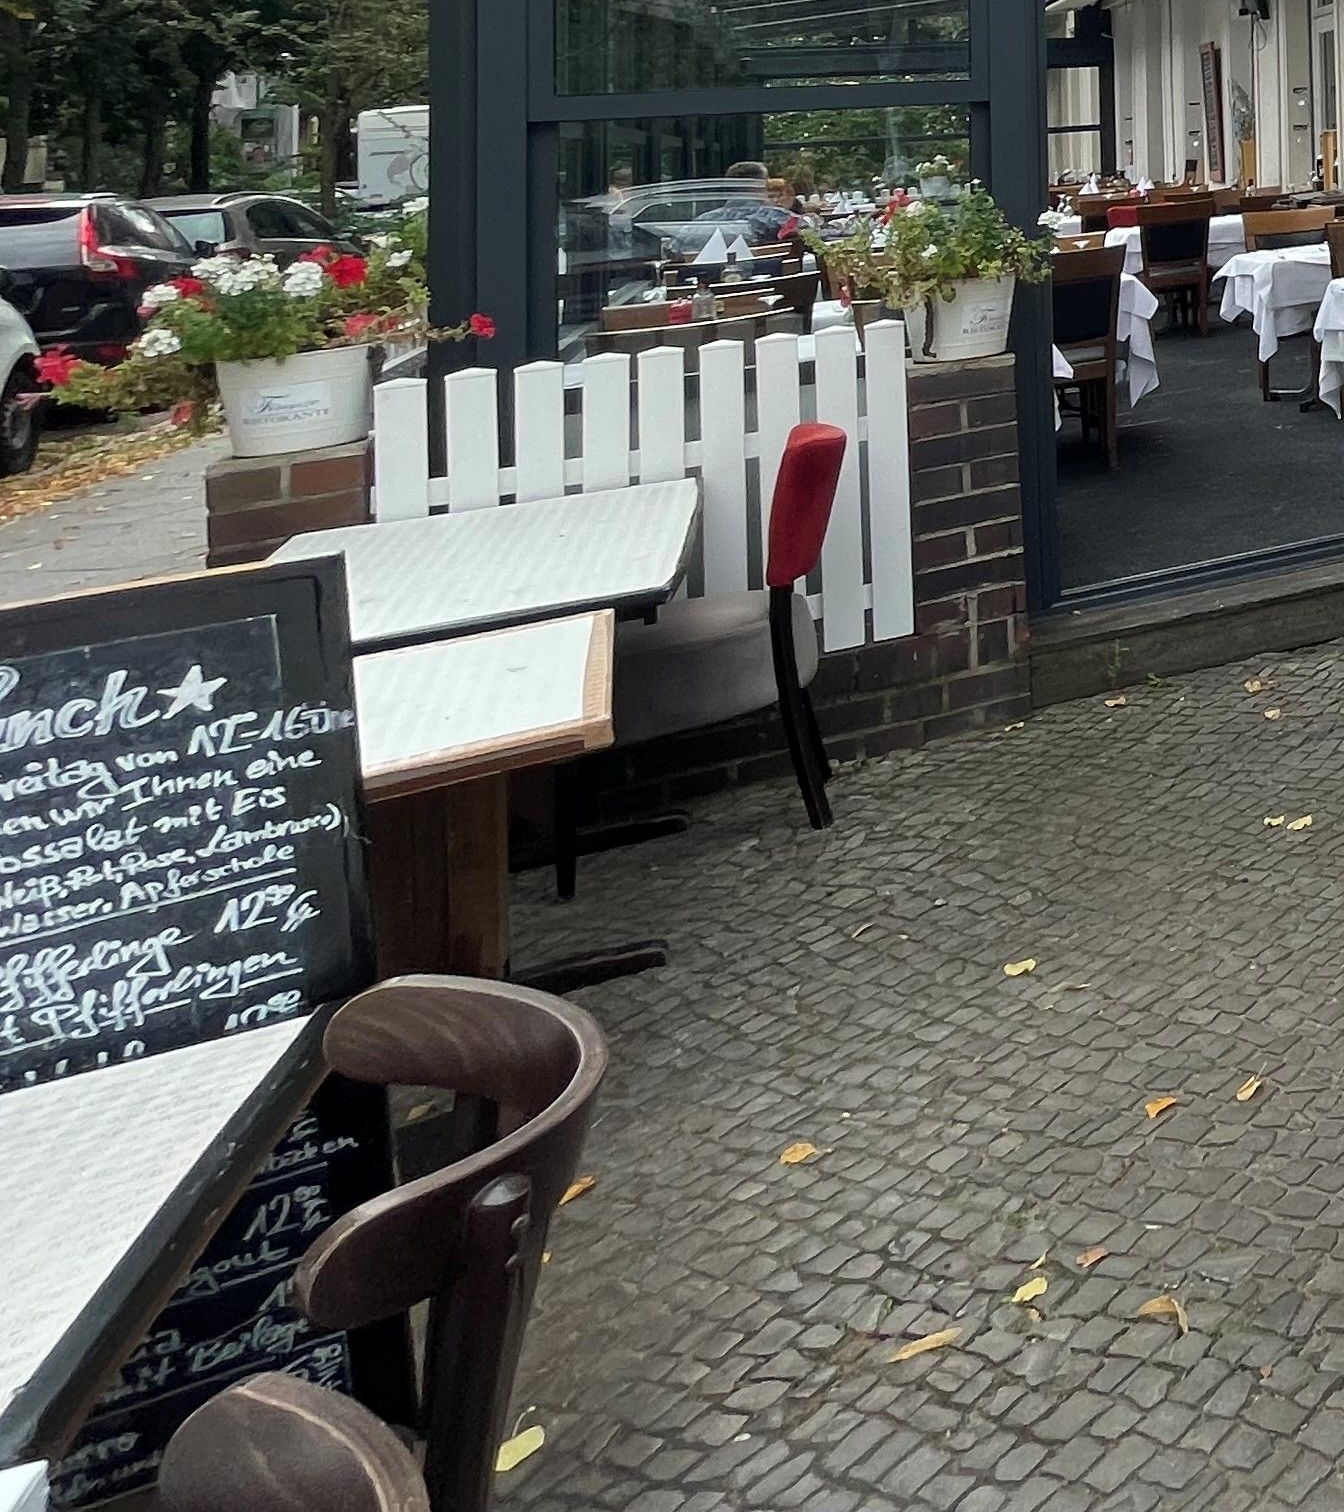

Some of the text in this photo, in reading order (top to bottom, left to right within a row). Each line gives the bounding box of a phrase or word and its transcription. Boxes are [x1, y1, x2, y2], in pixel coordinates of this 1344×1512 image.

[115, 749, 179, 772] von
[121, 767, 240, 812] Ihnen
[245, 749, 322, 780] eine
[153, 797, 224, 833] mit
[231, 785, 287, 816] Eis
